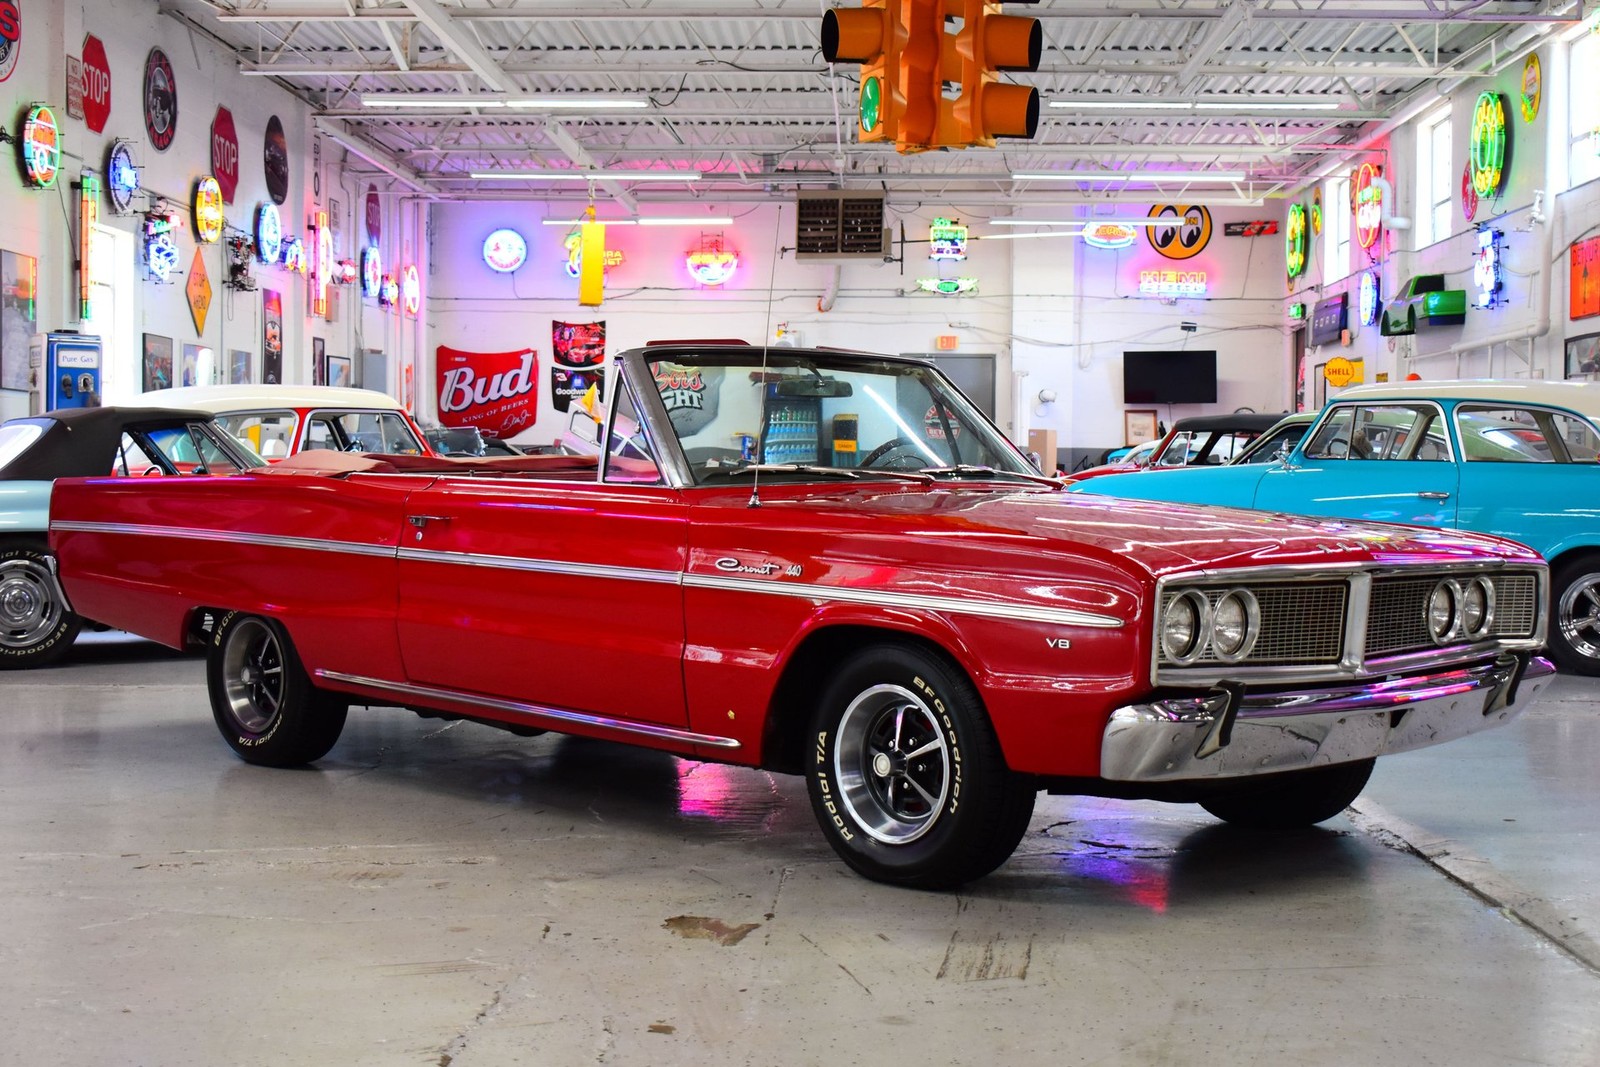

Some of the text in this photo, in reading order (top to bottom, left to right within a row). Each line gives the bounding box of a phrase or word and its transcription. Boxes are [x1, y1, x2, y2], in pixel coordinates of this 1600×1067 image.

[82, 62, 109, 105] STOP
[213, 134, 237, 176] STOP
[62, 355, 94, 363] Pure Gas
[440, 352, 534, 413] Bud
[555, 372, 568, 382] 3
[1327, 367, 1351, 376] SHELL
[462, 398, 529, 424] KING OF BEERS
[715, 557, 803, 577] Coronet 440
[1046, 637, 1070, 650] V8
[816, 730, 854, 841] Radial T/A
